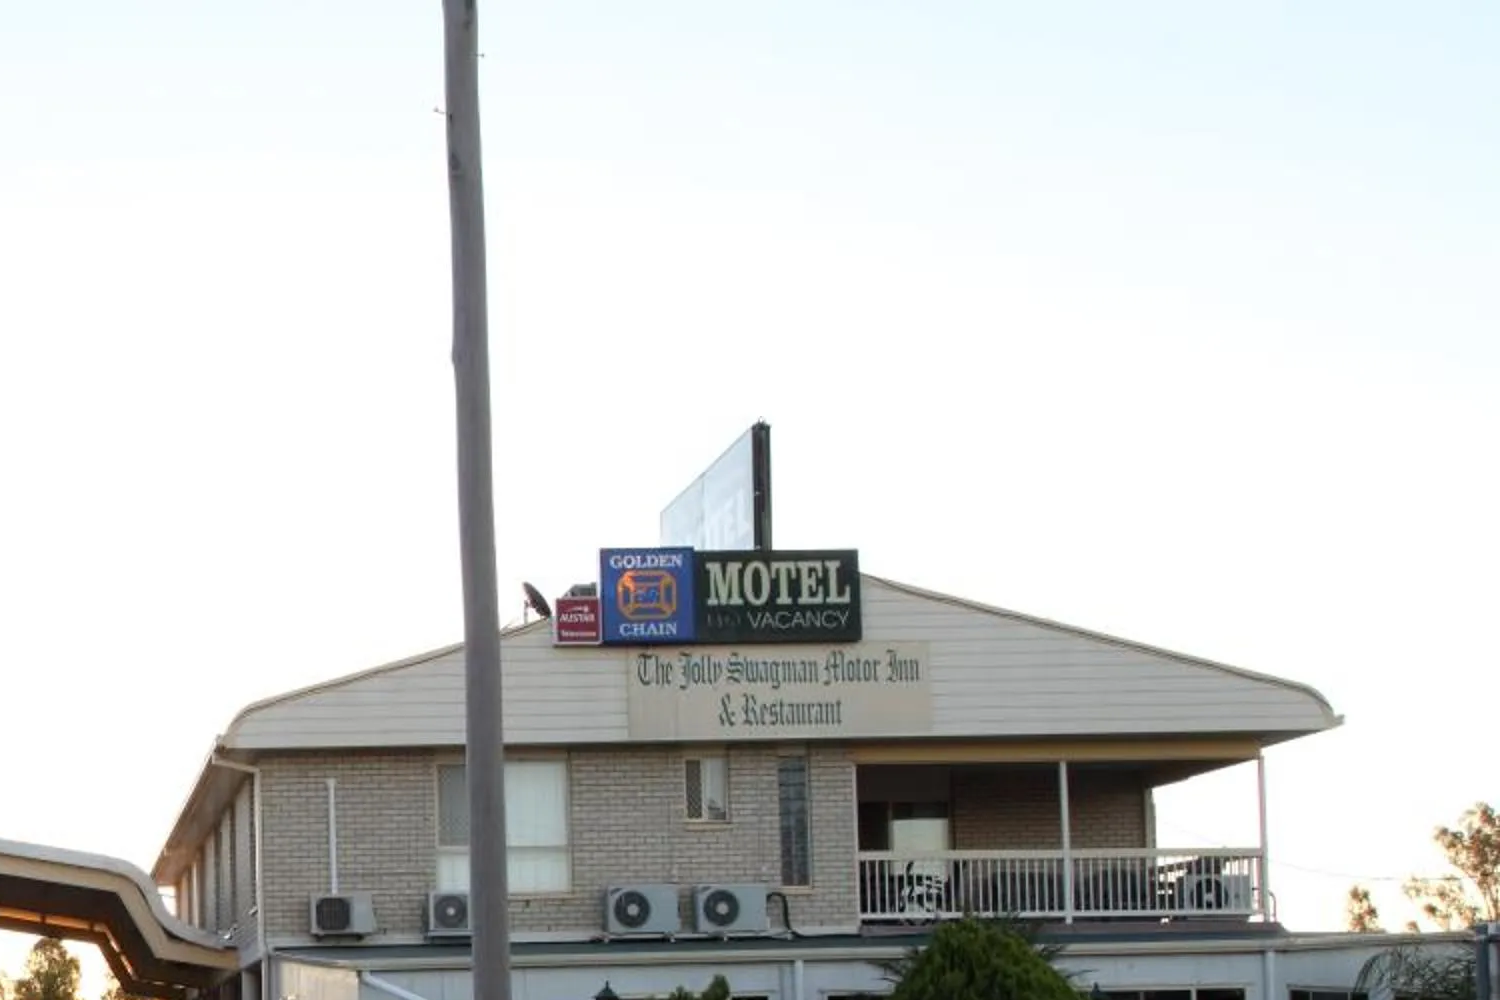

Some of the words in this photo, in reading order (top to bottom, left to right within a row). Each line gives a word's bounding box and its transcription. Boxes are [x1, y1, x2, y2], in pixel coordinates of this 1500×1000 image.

[609, 552, 683, 569] GOLDEN
[705, 560, 851, 606] MOTEL
[619, 622, 677, 637] CHAIN
[747, 610, 850, 630] VACANCY
[637, 652, 673, 686] The
[679, 651, 723, 690] Jolly
[726, 651, 820, 690] Swagman
[823, 649, 881, 686] Motor
[885, 649, 920, 683] Inn
[719, 693, 737, 727] &
[742, 693, 842, 726] Restaurant
